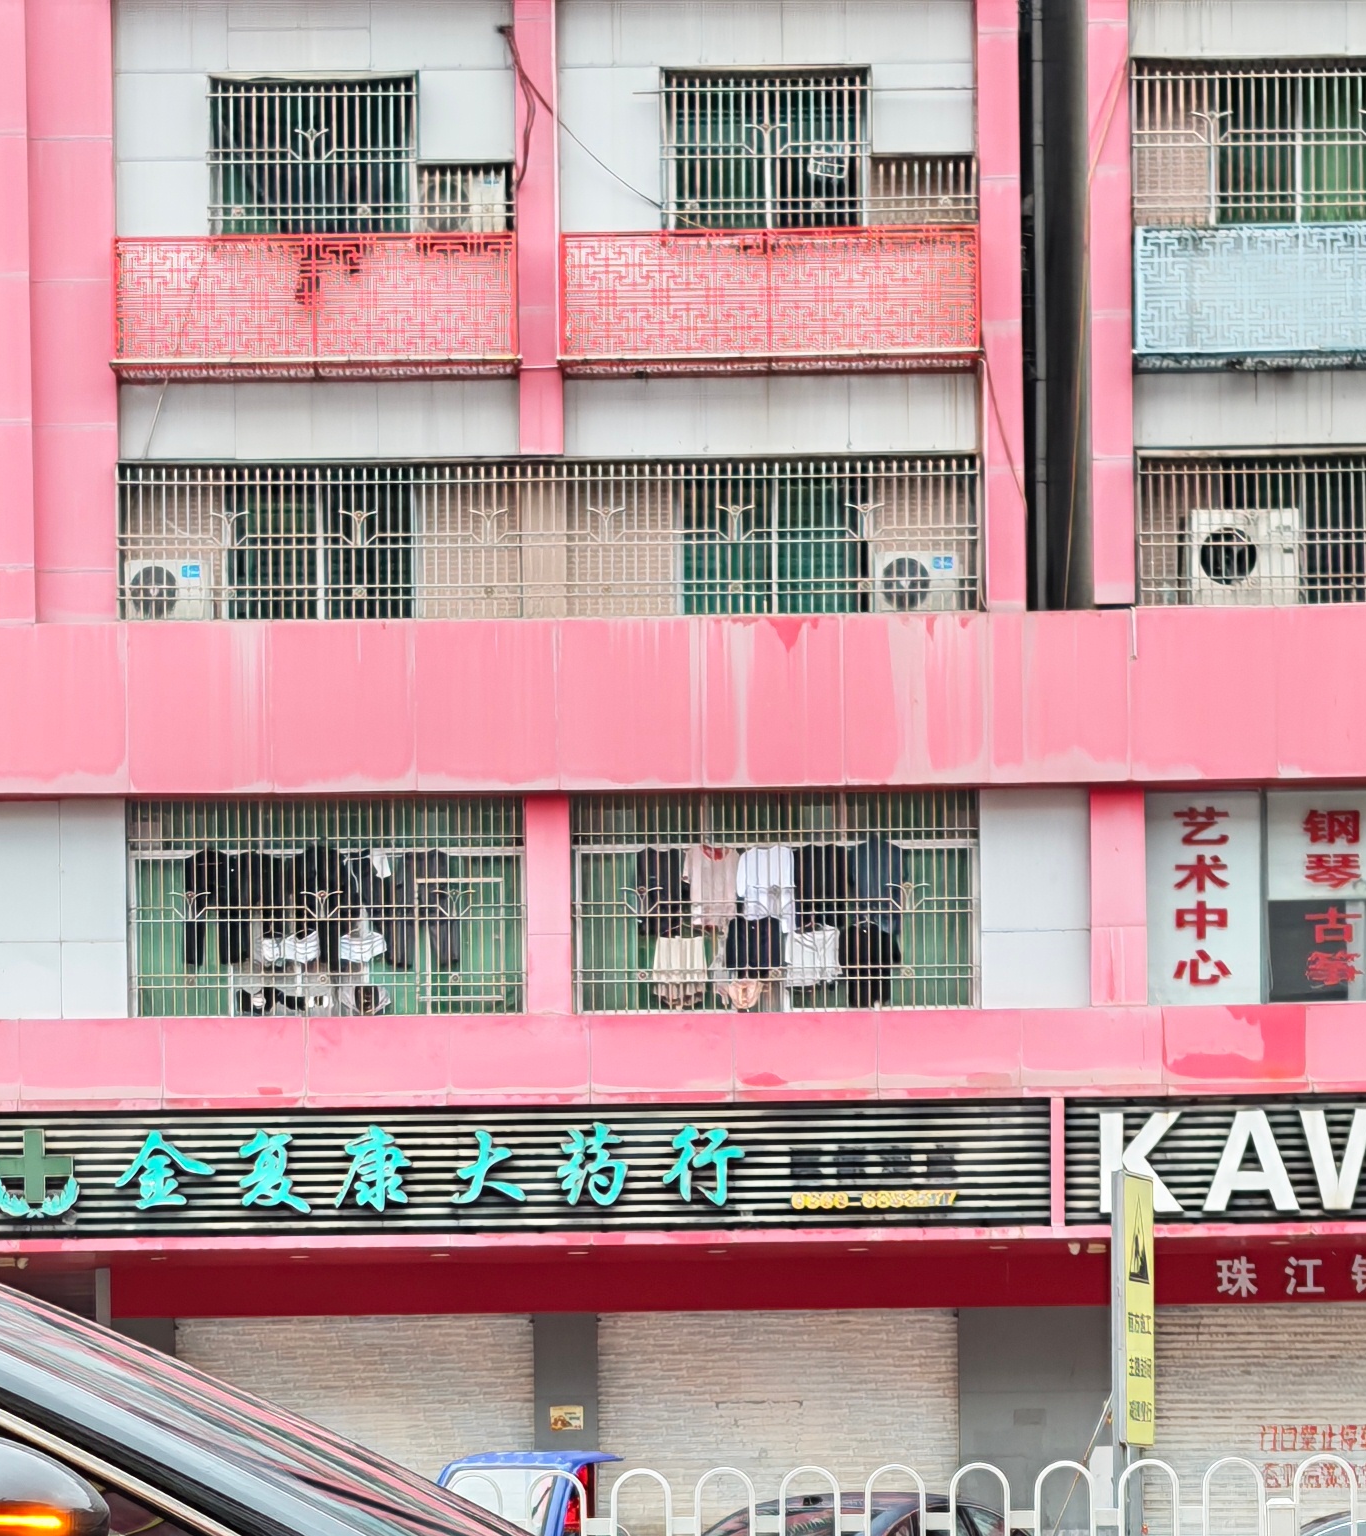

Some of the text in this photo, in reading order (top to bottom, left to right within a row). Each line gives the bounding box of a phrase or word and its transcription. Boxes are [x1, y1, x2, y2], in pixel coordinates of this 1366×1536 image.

[1173, 806, 1233, 987] 艺术中心
[1303, 808, 1365, 986] 钢琴古筝
